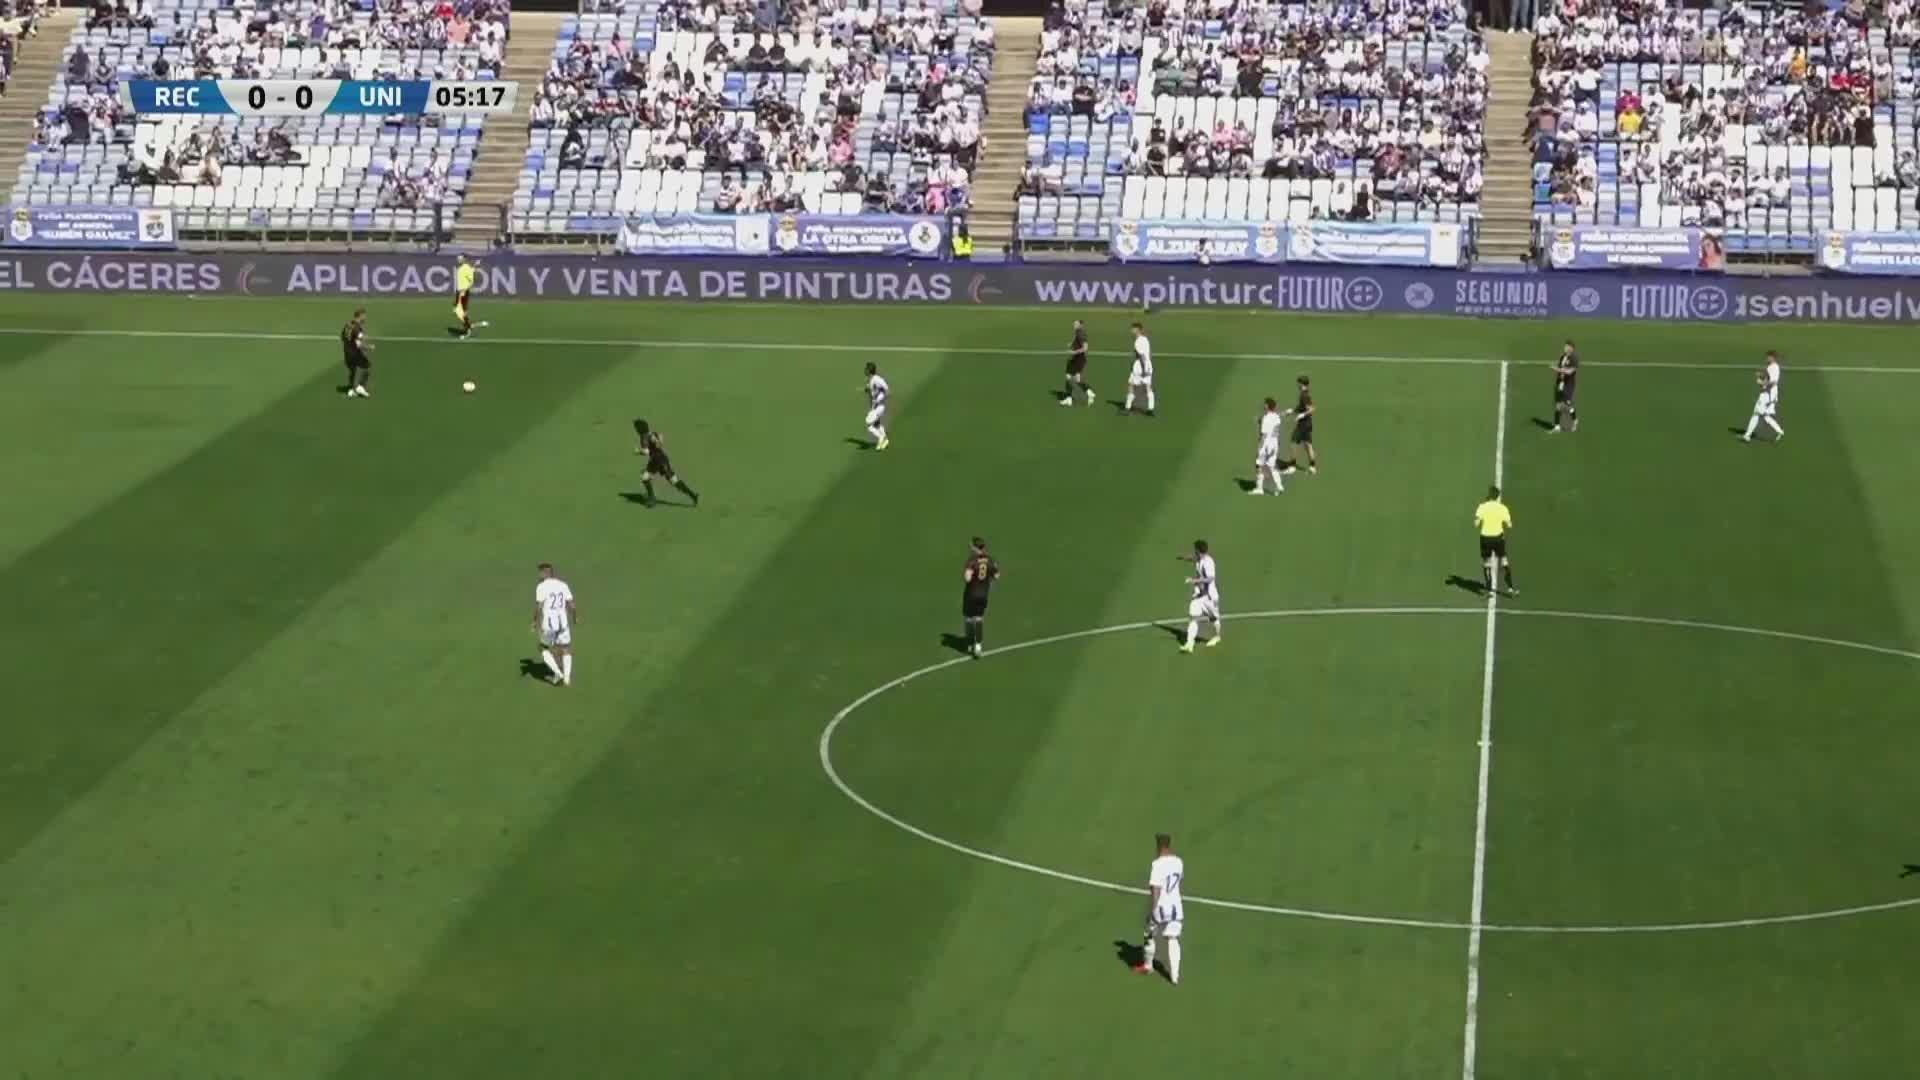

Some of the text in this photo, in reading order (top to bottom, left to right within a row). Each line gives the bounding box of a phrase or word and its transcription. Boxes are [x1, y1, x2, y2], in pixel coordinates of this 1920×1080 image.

[46, 256, 221, 290] CÁCERES
[528, 267, 551, 295] Y
[562, 268, 689, 297] VENTA
[700, 271, 747, 299] DE
[758, 272, 952, 301] PINTURAS
[1455, 279, 1549, 305] SEGUNDA
[549, 591, 564, 610] 23
